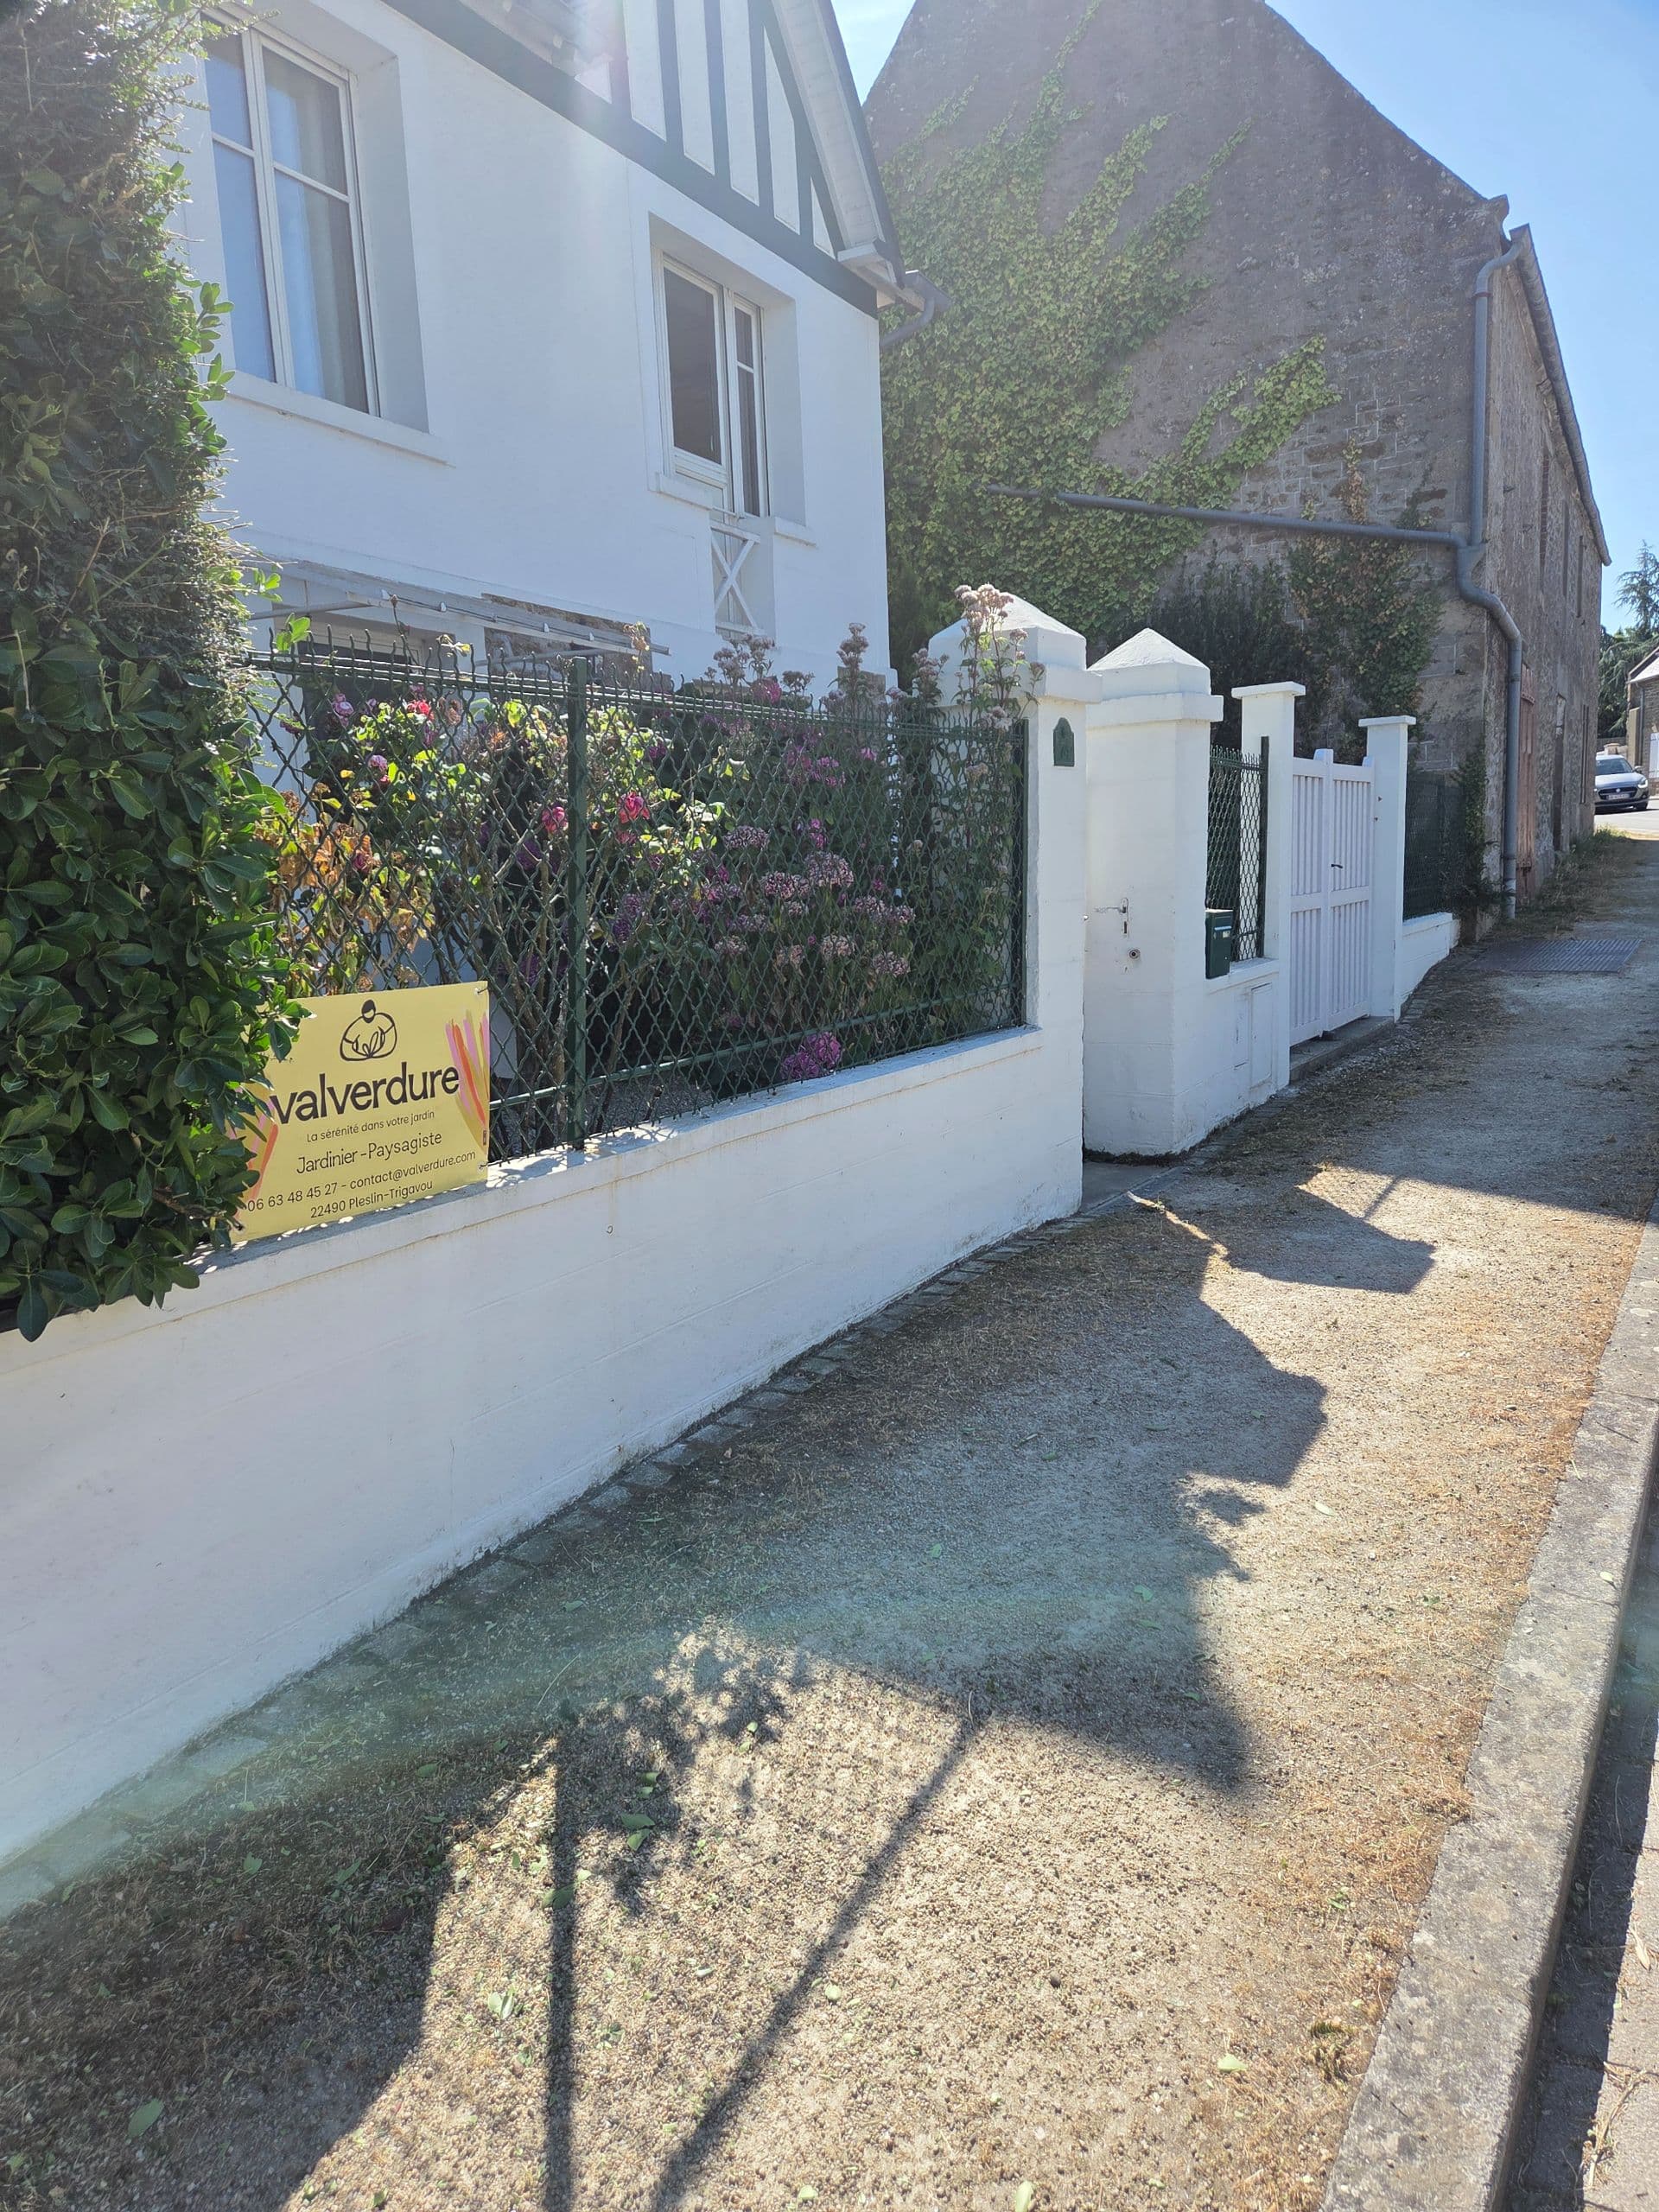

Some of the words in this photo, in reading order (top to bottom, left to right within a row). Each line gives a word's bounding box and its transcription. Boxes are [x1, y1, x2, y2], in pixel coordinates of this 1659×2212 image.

[270, 1062, 459, 1124] valverdure
[307, 1134, 318, 1142] La
[321, 1123, 359, 1140] sérénité
[361, 1122, 384, 1132] dans
[386, 1116, 409, 1127] votre
[410, 1110, 435, 1125] jardin
[248, 1198, 264, 1211] 06
[268, 1194, 283, 1208] 63
[288, 1190, 303, 1203] 48
[307, 1186, 321, 1199] 45
[325, 1183, 338, 1195] 27
[350, 1151, 476, 1189] contact@valverdure.com
[310, 1200, 346, 1218] 22490
[349, 1181, 433, 1209] Pleslin-Trigavou
